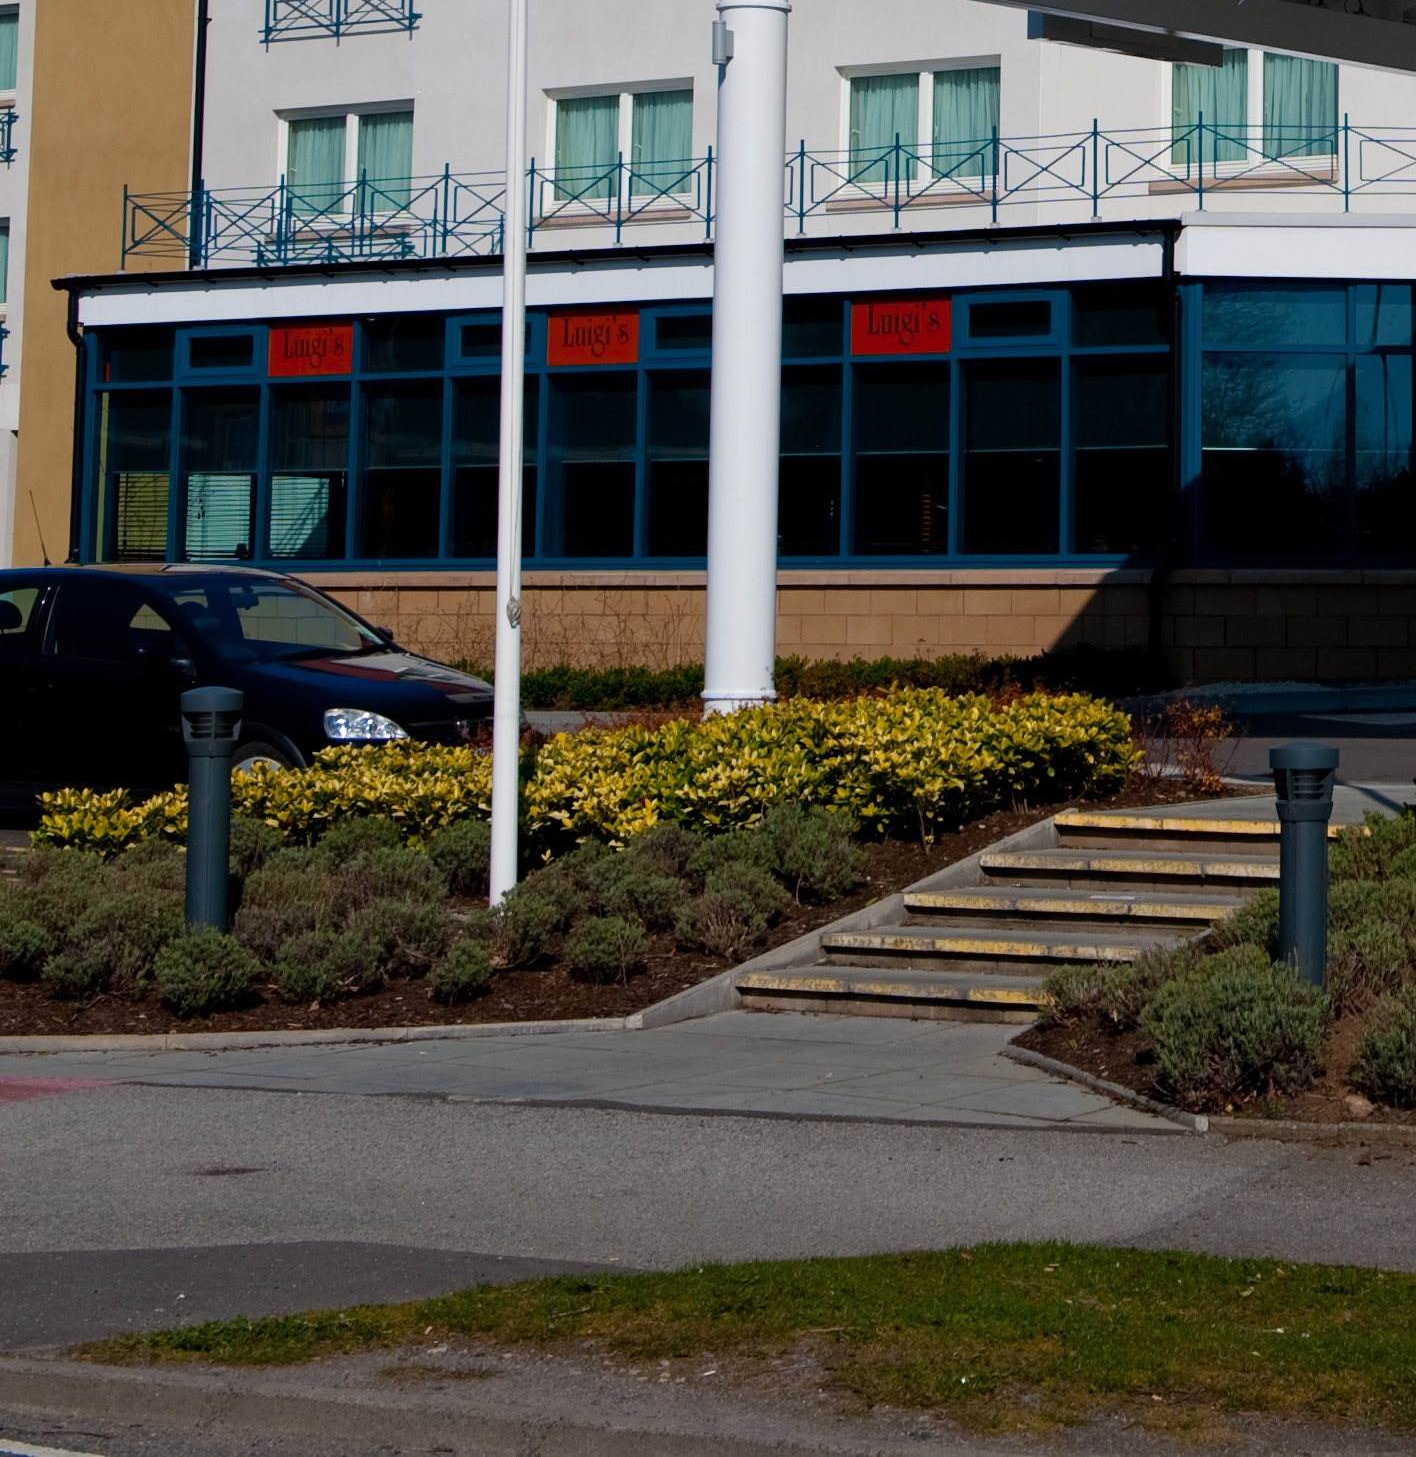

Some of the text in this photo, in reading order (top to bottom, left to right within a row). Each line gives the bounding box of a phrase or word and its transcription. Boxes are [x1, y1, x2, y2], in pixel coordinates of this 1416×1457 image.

[561, 314, 630, 358] Luigi's
[866, 302, 941, 347] Luigi's
[282, 327, 346, 369] Luigi's
